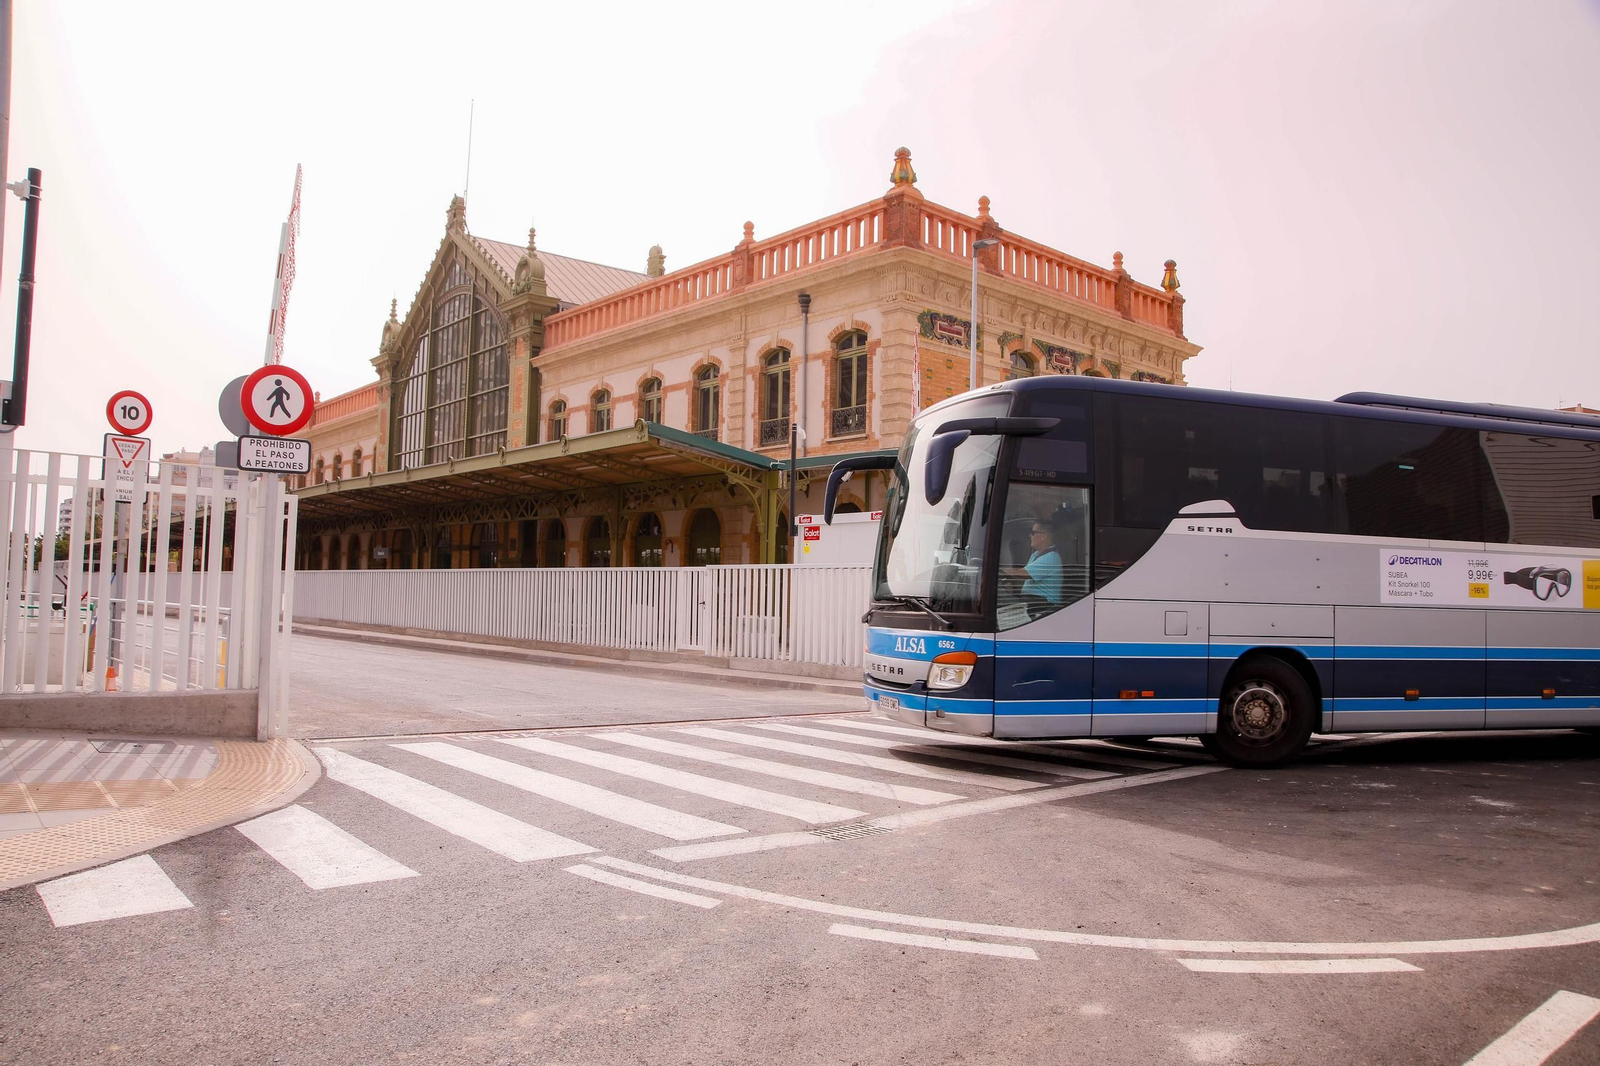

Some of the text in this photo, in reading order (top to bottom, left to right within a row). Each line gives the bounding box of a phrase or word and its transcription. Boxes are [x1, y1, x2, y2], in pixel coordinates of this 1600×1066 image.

[120, 404, 140, 420] 10
[250, 439, 301, 450] PROHIBIDO
[270, 451, 294, 459] PASO
[255, 460, 304, 470] PEATONES
[1400, 556, 1442, 566] DECATHLON
[1468, 570, 1493, 581] 9,99€
[895, 636, 955, 654] ALSA 6562
[872, 663, 904, 675] SETRA
